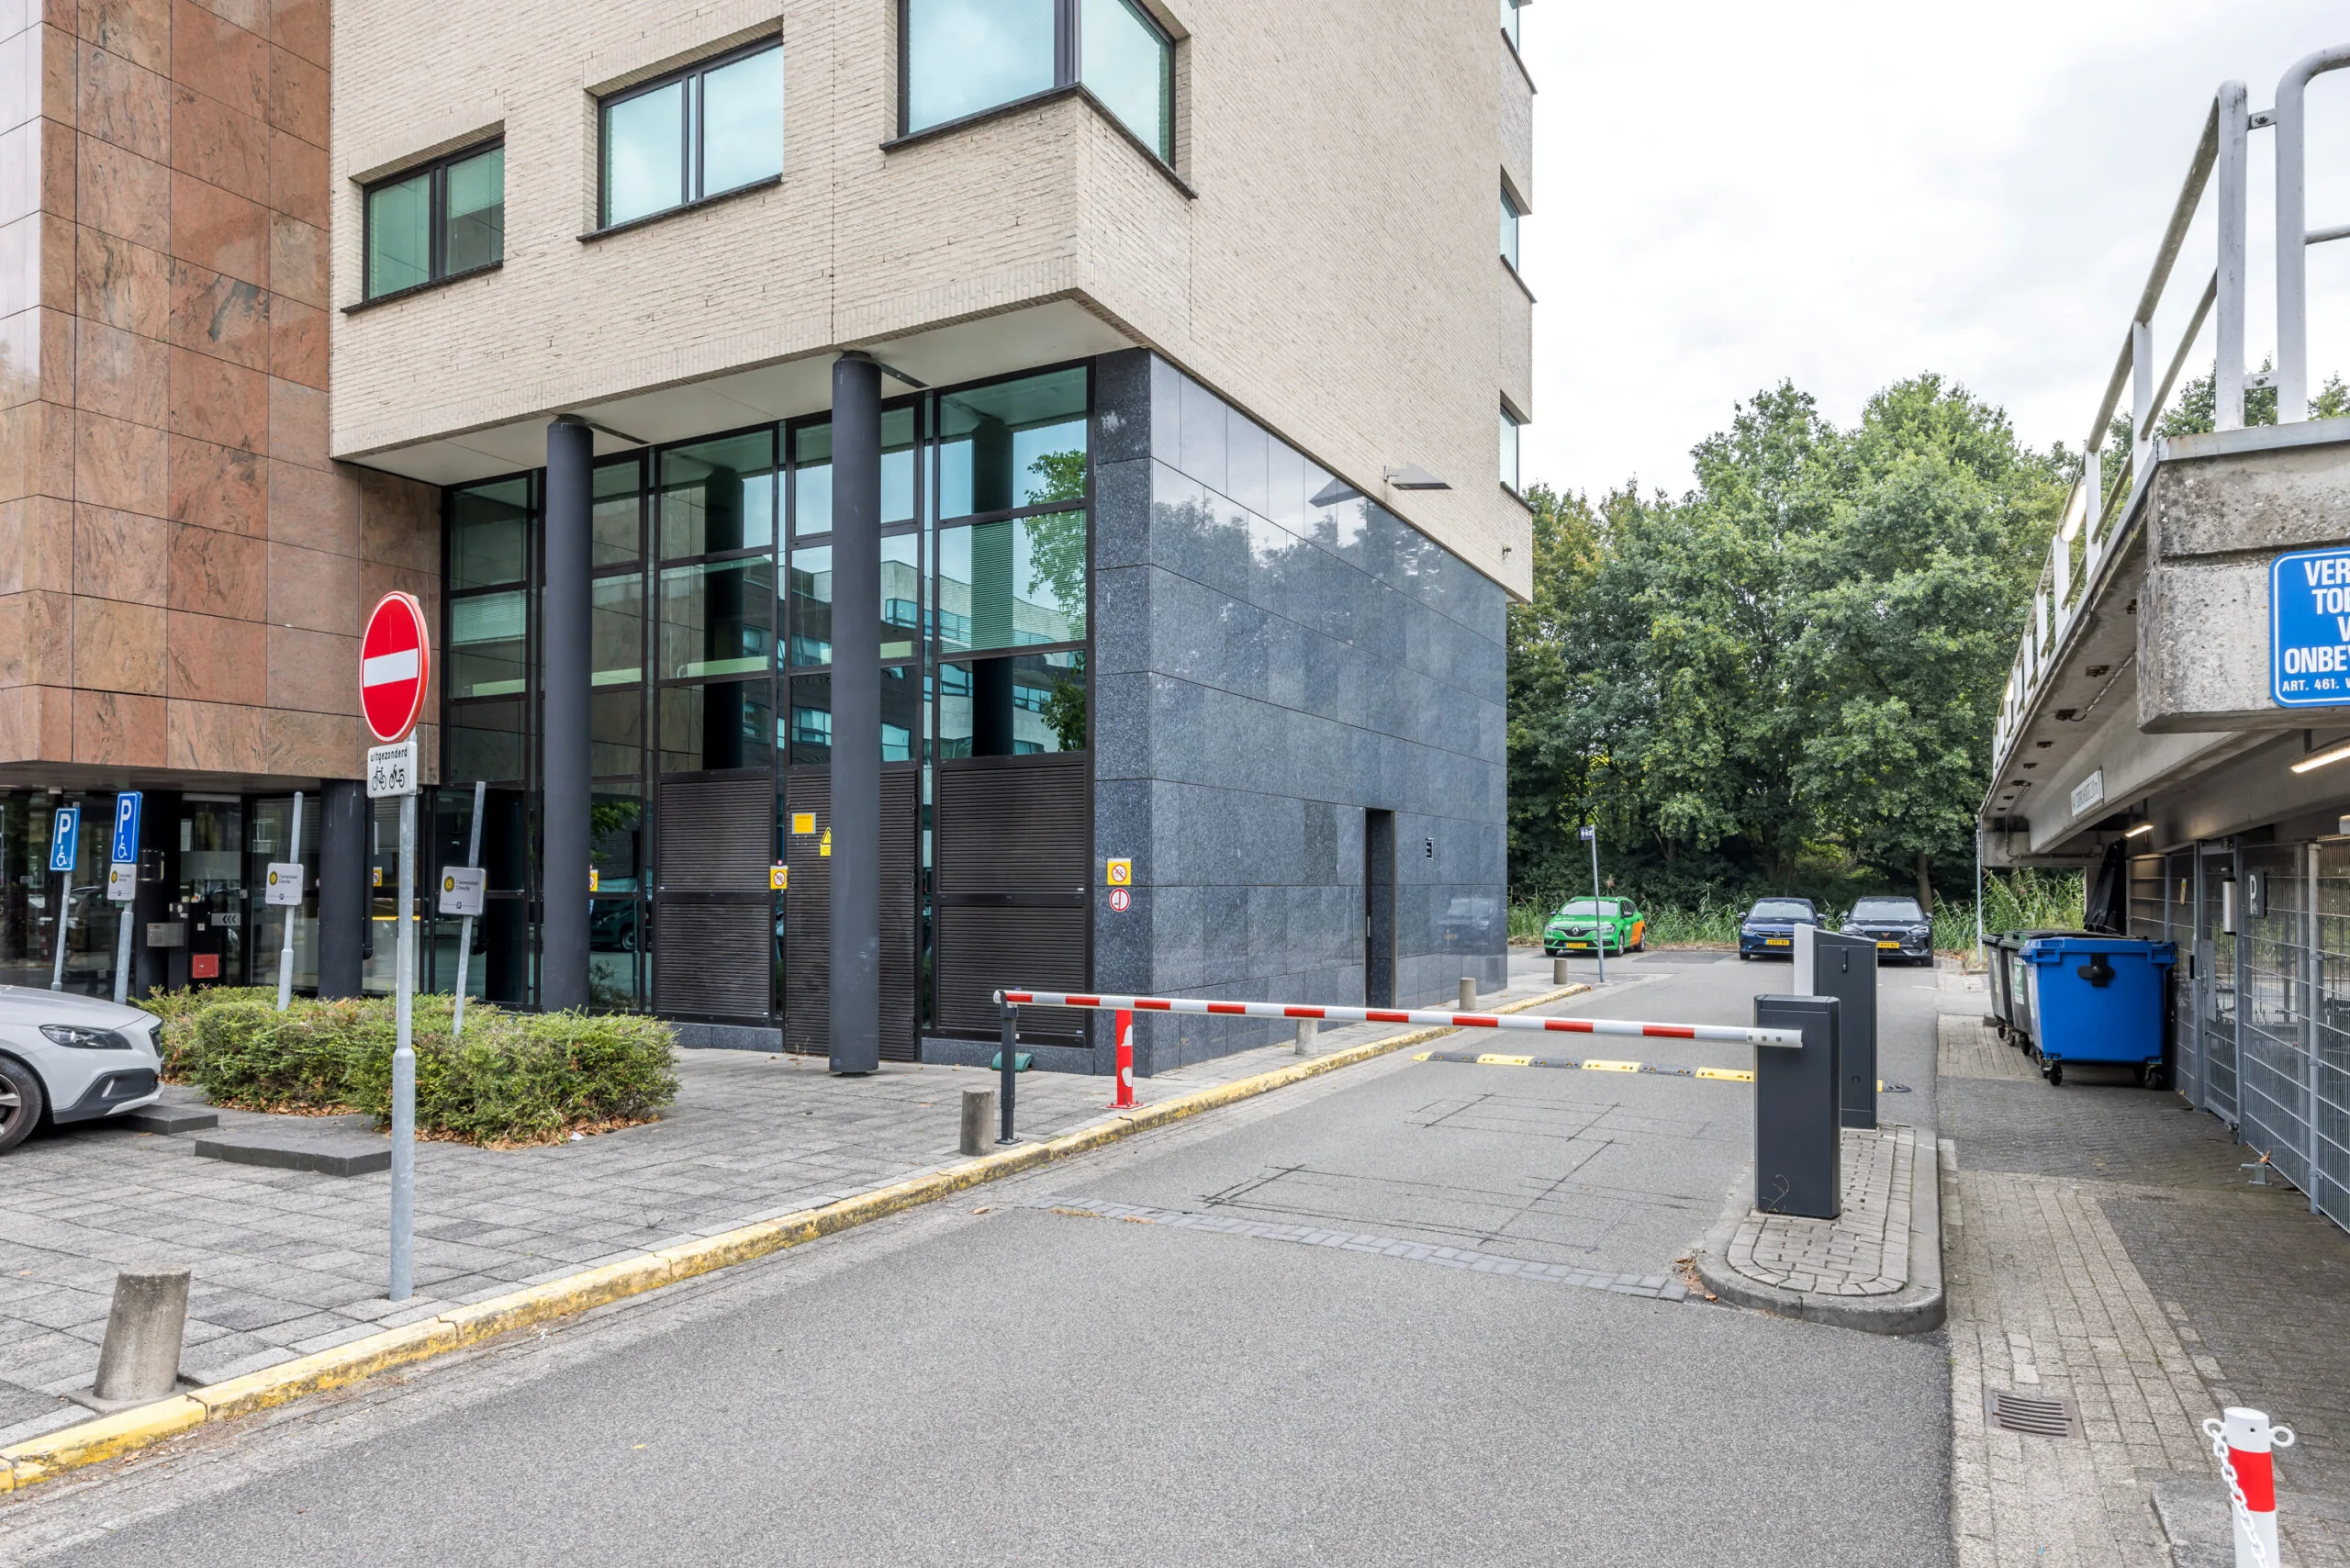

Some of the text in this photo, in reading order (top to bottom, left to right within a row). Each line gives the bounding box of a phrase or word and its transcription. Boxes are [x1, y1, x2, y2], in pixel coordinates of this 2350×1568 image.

[2284, 644, 2350, 675] ONBE
[2282, 679, 2310, 692] ART.
[371, 745, 407, 764] uitgezonderd
[57, 813, 71, 844] P
[119, 800, 132, 833] P
[2249, 874, 2257, 915] P
